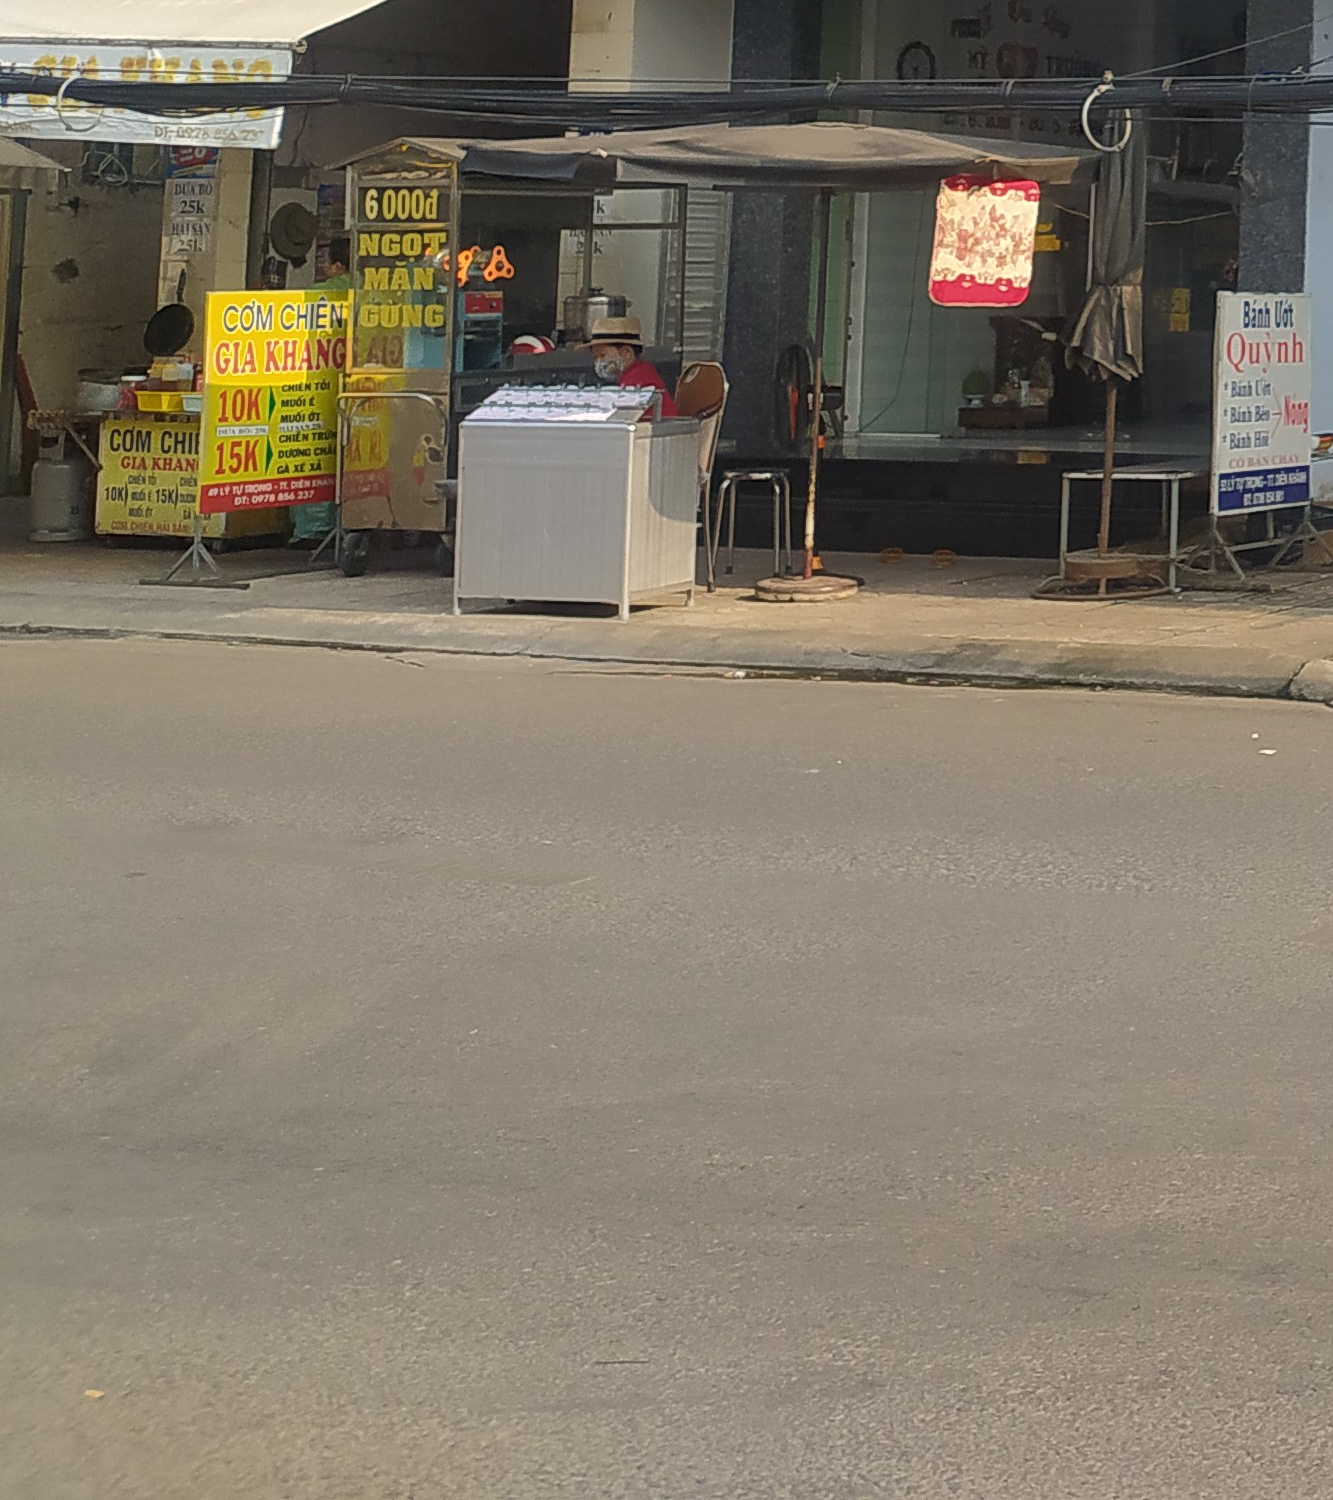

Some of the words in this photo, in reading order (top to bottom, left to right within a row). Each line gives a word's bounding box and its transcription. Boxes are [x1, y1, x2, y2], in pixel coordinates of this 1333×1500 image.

[180, 200, 204, 214] 25k
[358, 232, 447, 263] NGỌT
[363, 261, 435, 296] MẶN
[223, 300, 273, 333] CƠM
[280, 296, 343, 331] CHIÊN
[1243, 299, 1271, 329] Bánh
[1274, 299, 1294, 329] Ướt
[215, 340, 257, 375] GIA
[264, 337, 347, 373] KHANG
[1226, 331, 1304, 374] Quỳnh
[1230, 379, 1253, 398] Bánh
[217, 388, 262, 423] 10K
[1230, 404, 1252, 423] Bánh
[109, 426, 152, 454] CƠM
[1229, 432, 1252, 450] Bánh
[120, 455, 148, 470] GIA
[151, 456, 200, 473] KHAN
[214, 439, 260, 476] 15K
[104, 485, 124, 502] 10K
[155, 488, 175, 505] 15K
[251, 494, 276, 504] 0978
[297, 489, 315, 500] 237
